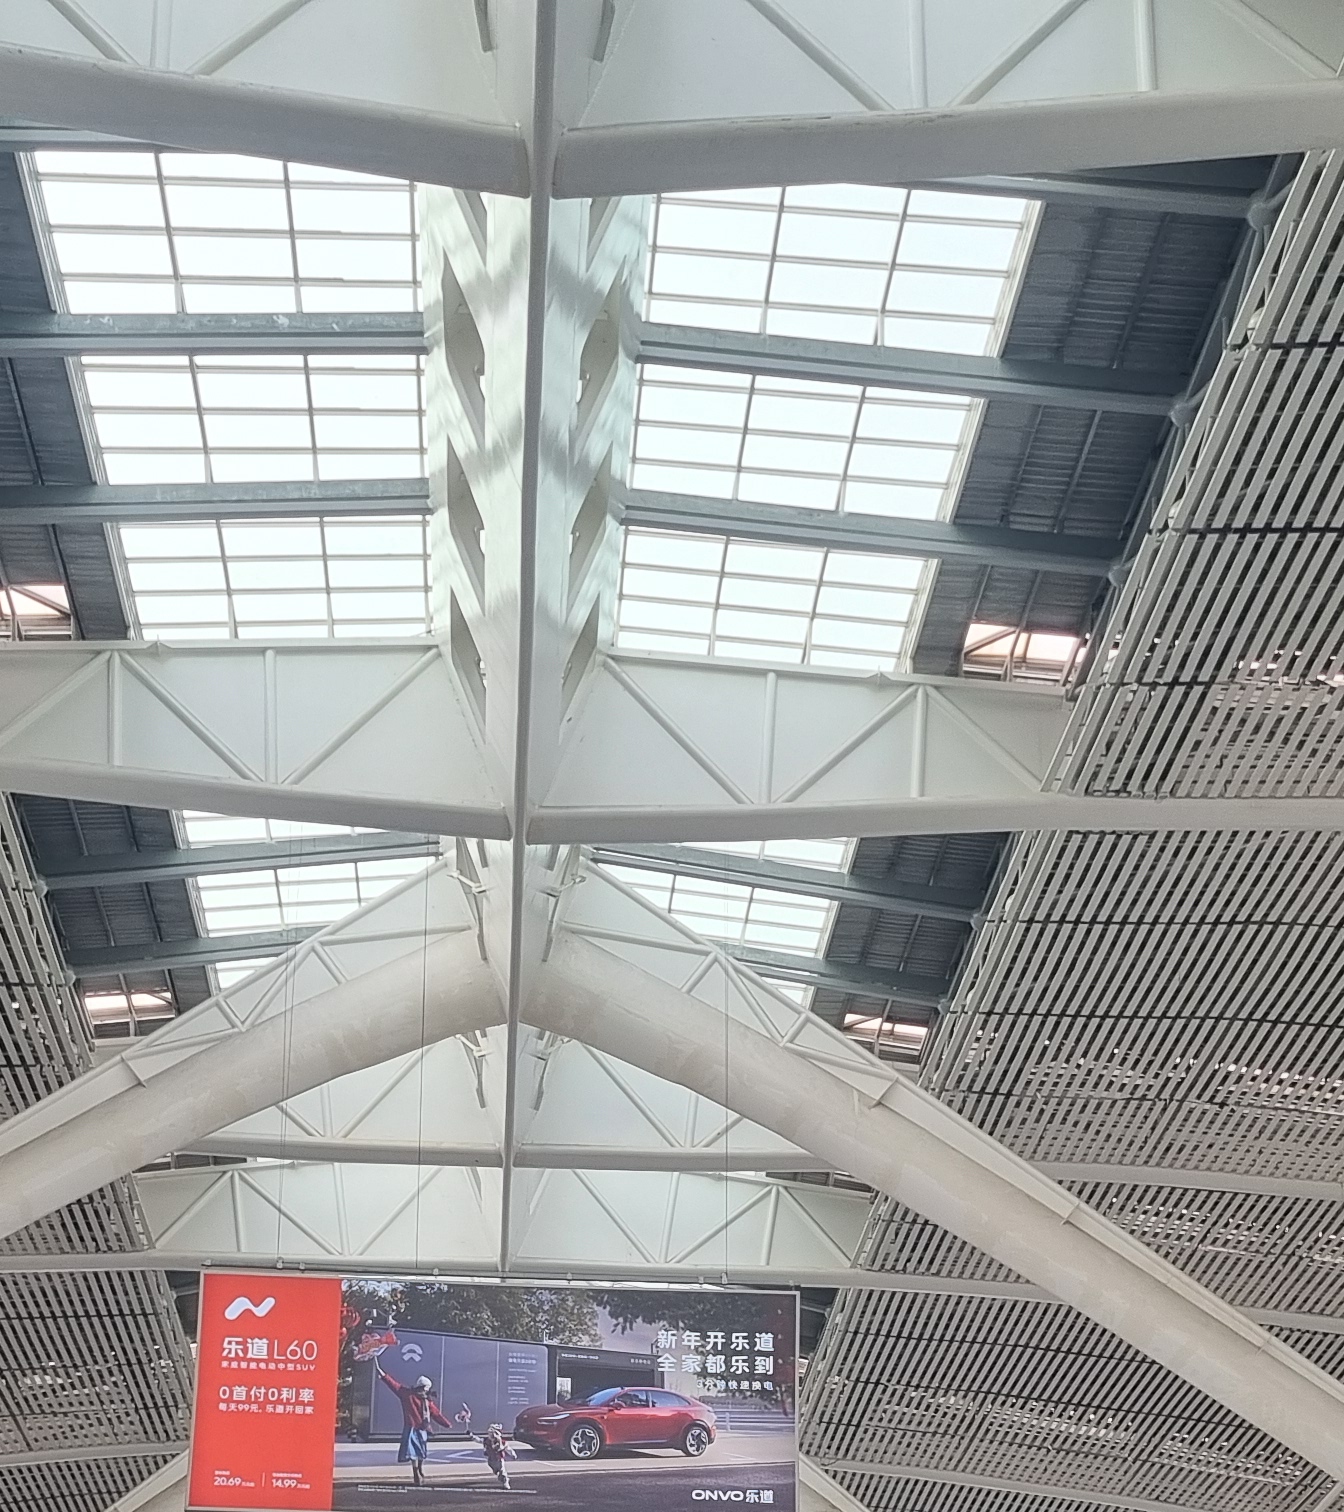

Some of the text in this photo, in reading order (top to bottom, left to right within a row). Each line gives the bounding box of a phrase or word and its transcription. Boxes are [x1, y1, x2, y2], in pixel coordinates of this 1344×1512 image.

[222, 1338, 318, 1360] 乐道 L60
[657, 1330, 775, 1352] 新年开乐道
[657, 1353, 774, 1376] 全家都乐到
[219, 1386, 315, 1403] 0首付0利率
[692, 1490, 774, 1504] ONVO 乐道
